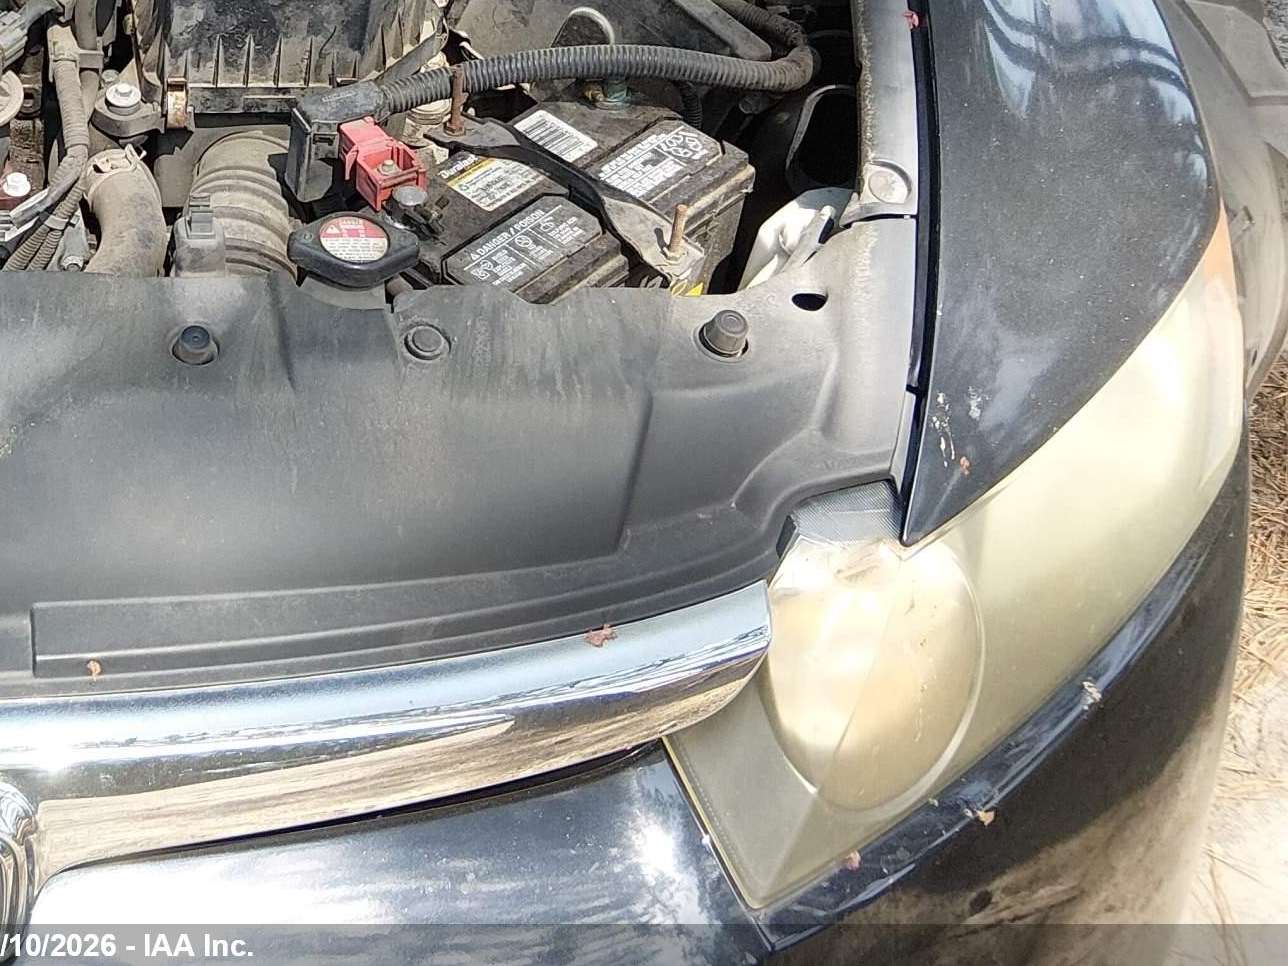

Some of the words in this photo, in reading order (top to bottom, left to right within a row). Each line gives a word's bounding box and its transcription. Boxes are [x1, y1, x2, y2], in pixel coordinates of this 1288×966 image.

[437, 153, 479, 179] Duralast
[475, 230, 512, 256] DANGER
[515, 209, 546, 231] POISON
